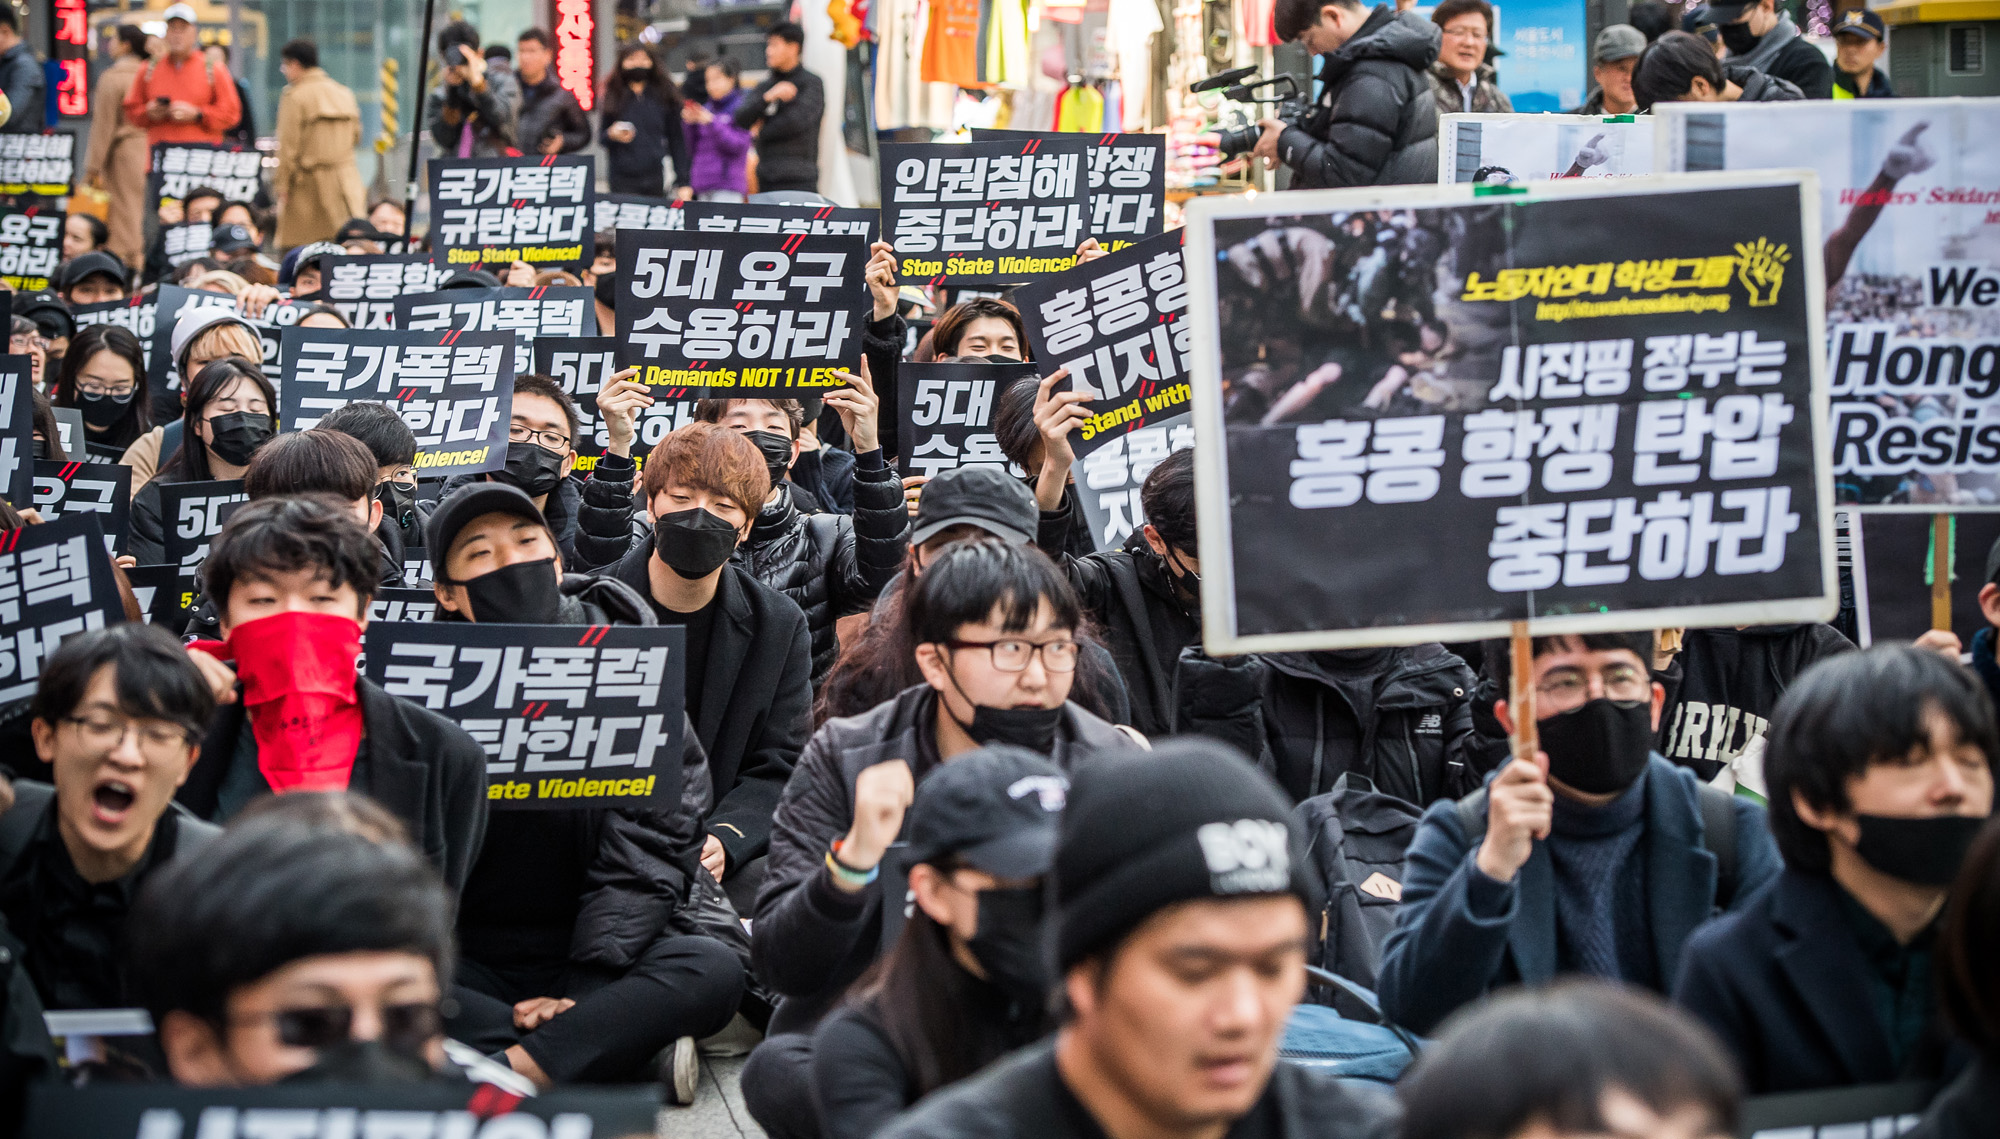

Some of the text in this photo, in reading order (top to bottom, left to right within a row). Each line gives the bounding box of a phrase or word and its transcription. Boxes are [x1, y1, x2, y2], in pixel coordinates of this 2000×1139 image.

[438, 165, 588, 206] 국가폭력
[893, 153, 1079, 203] 인권침해
[440, 205, 588, 245] 규탄한다
[893, 204, 1083, 253] 중단하라
[447, 245, 583, 264] Stop State Violence!
[631, 248, 847, 302] 5대 요구
[901, 254, 1078, 277] Stop State Violence!
[1930, 266, 2000, 307] We
[628, 307, 851, 360] 수용하라
[295, 342, 503, 394] 국가폭력
[645, 366, 737, 387] Demands
[740, 367, 783, 387] NOT
[785, 367, 797, 387] 1
[1488, 330, 1787, 402] 시진핑 정부는
[1832, 331, 2000, 399] Hong
[911, 379, 996, 427] 5대
[1081, 382, 1191, 442] Stand with
[1289, 393, 1795, 510] 홍콩 항쟁 탄압
[1486, 486, 1800, 593] 중단하라
[384, 643, 669, 709] 국가폭력
[536, 775, 656, 799] Violence!
